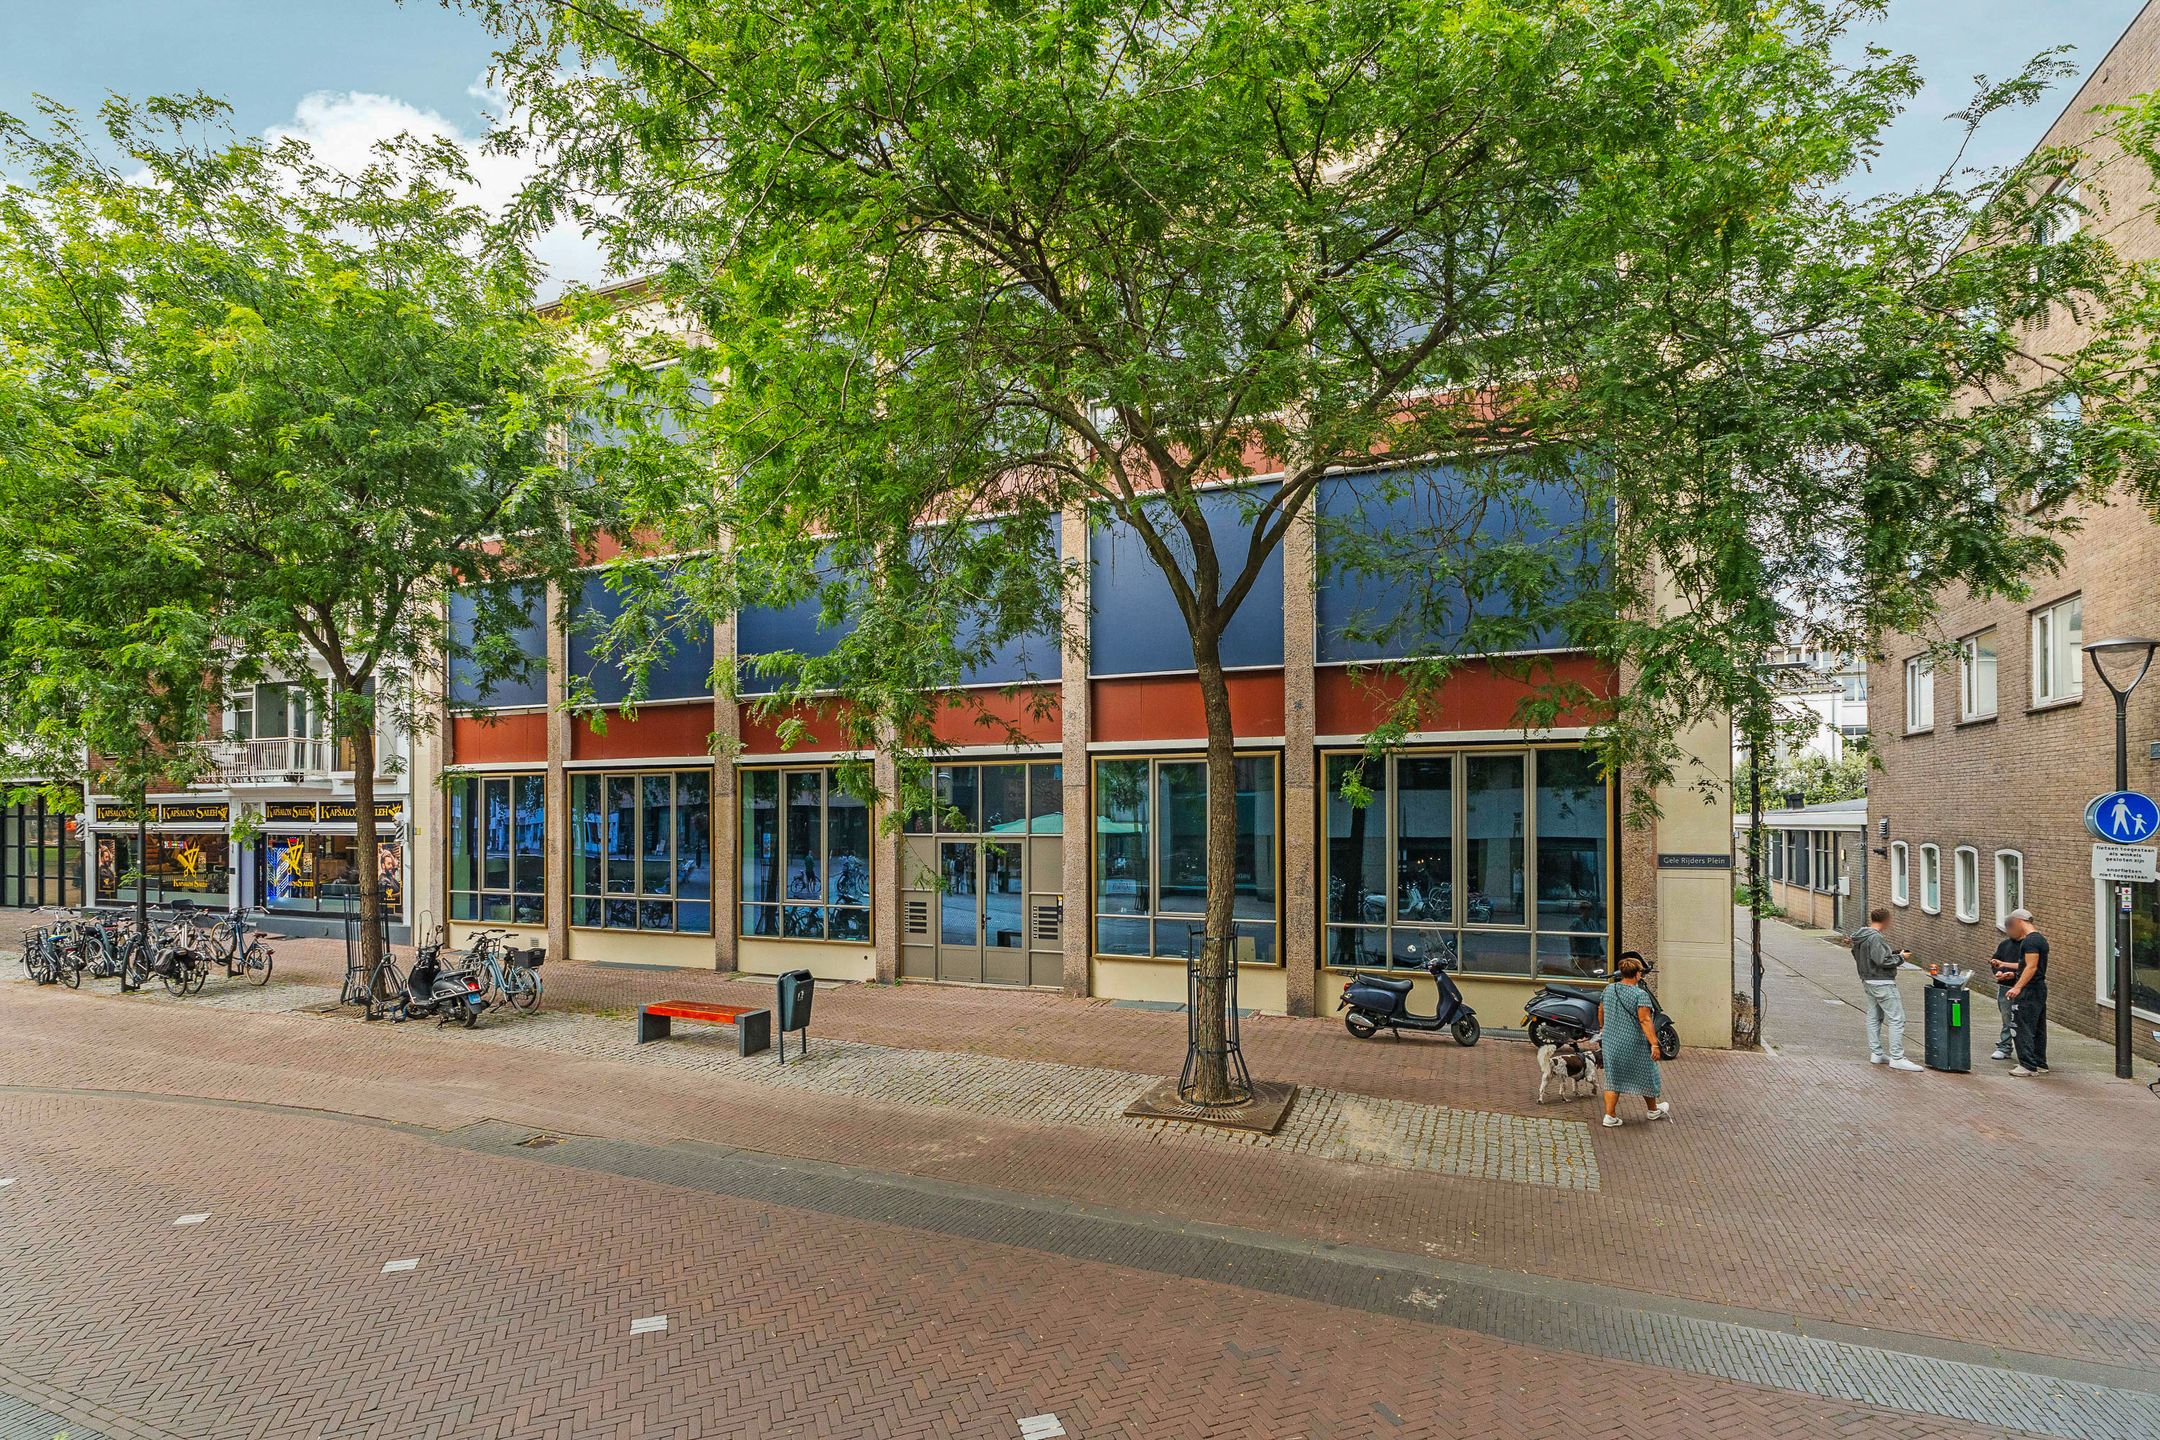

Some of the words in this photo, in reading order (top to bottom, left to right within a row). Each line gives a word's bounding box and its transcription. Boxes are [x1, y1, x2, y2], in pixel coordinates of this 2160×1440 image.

[162, 807, 195, 819] KAPSALON
[196, 806, 219, 819] SALEH
[267, 805, 292, 818] KAPSALON
[292, 805, 310, 818] SALEH
[320, 805, 357, 819] KAPSALO
[1681, 857, 1705, 865] Rijders
